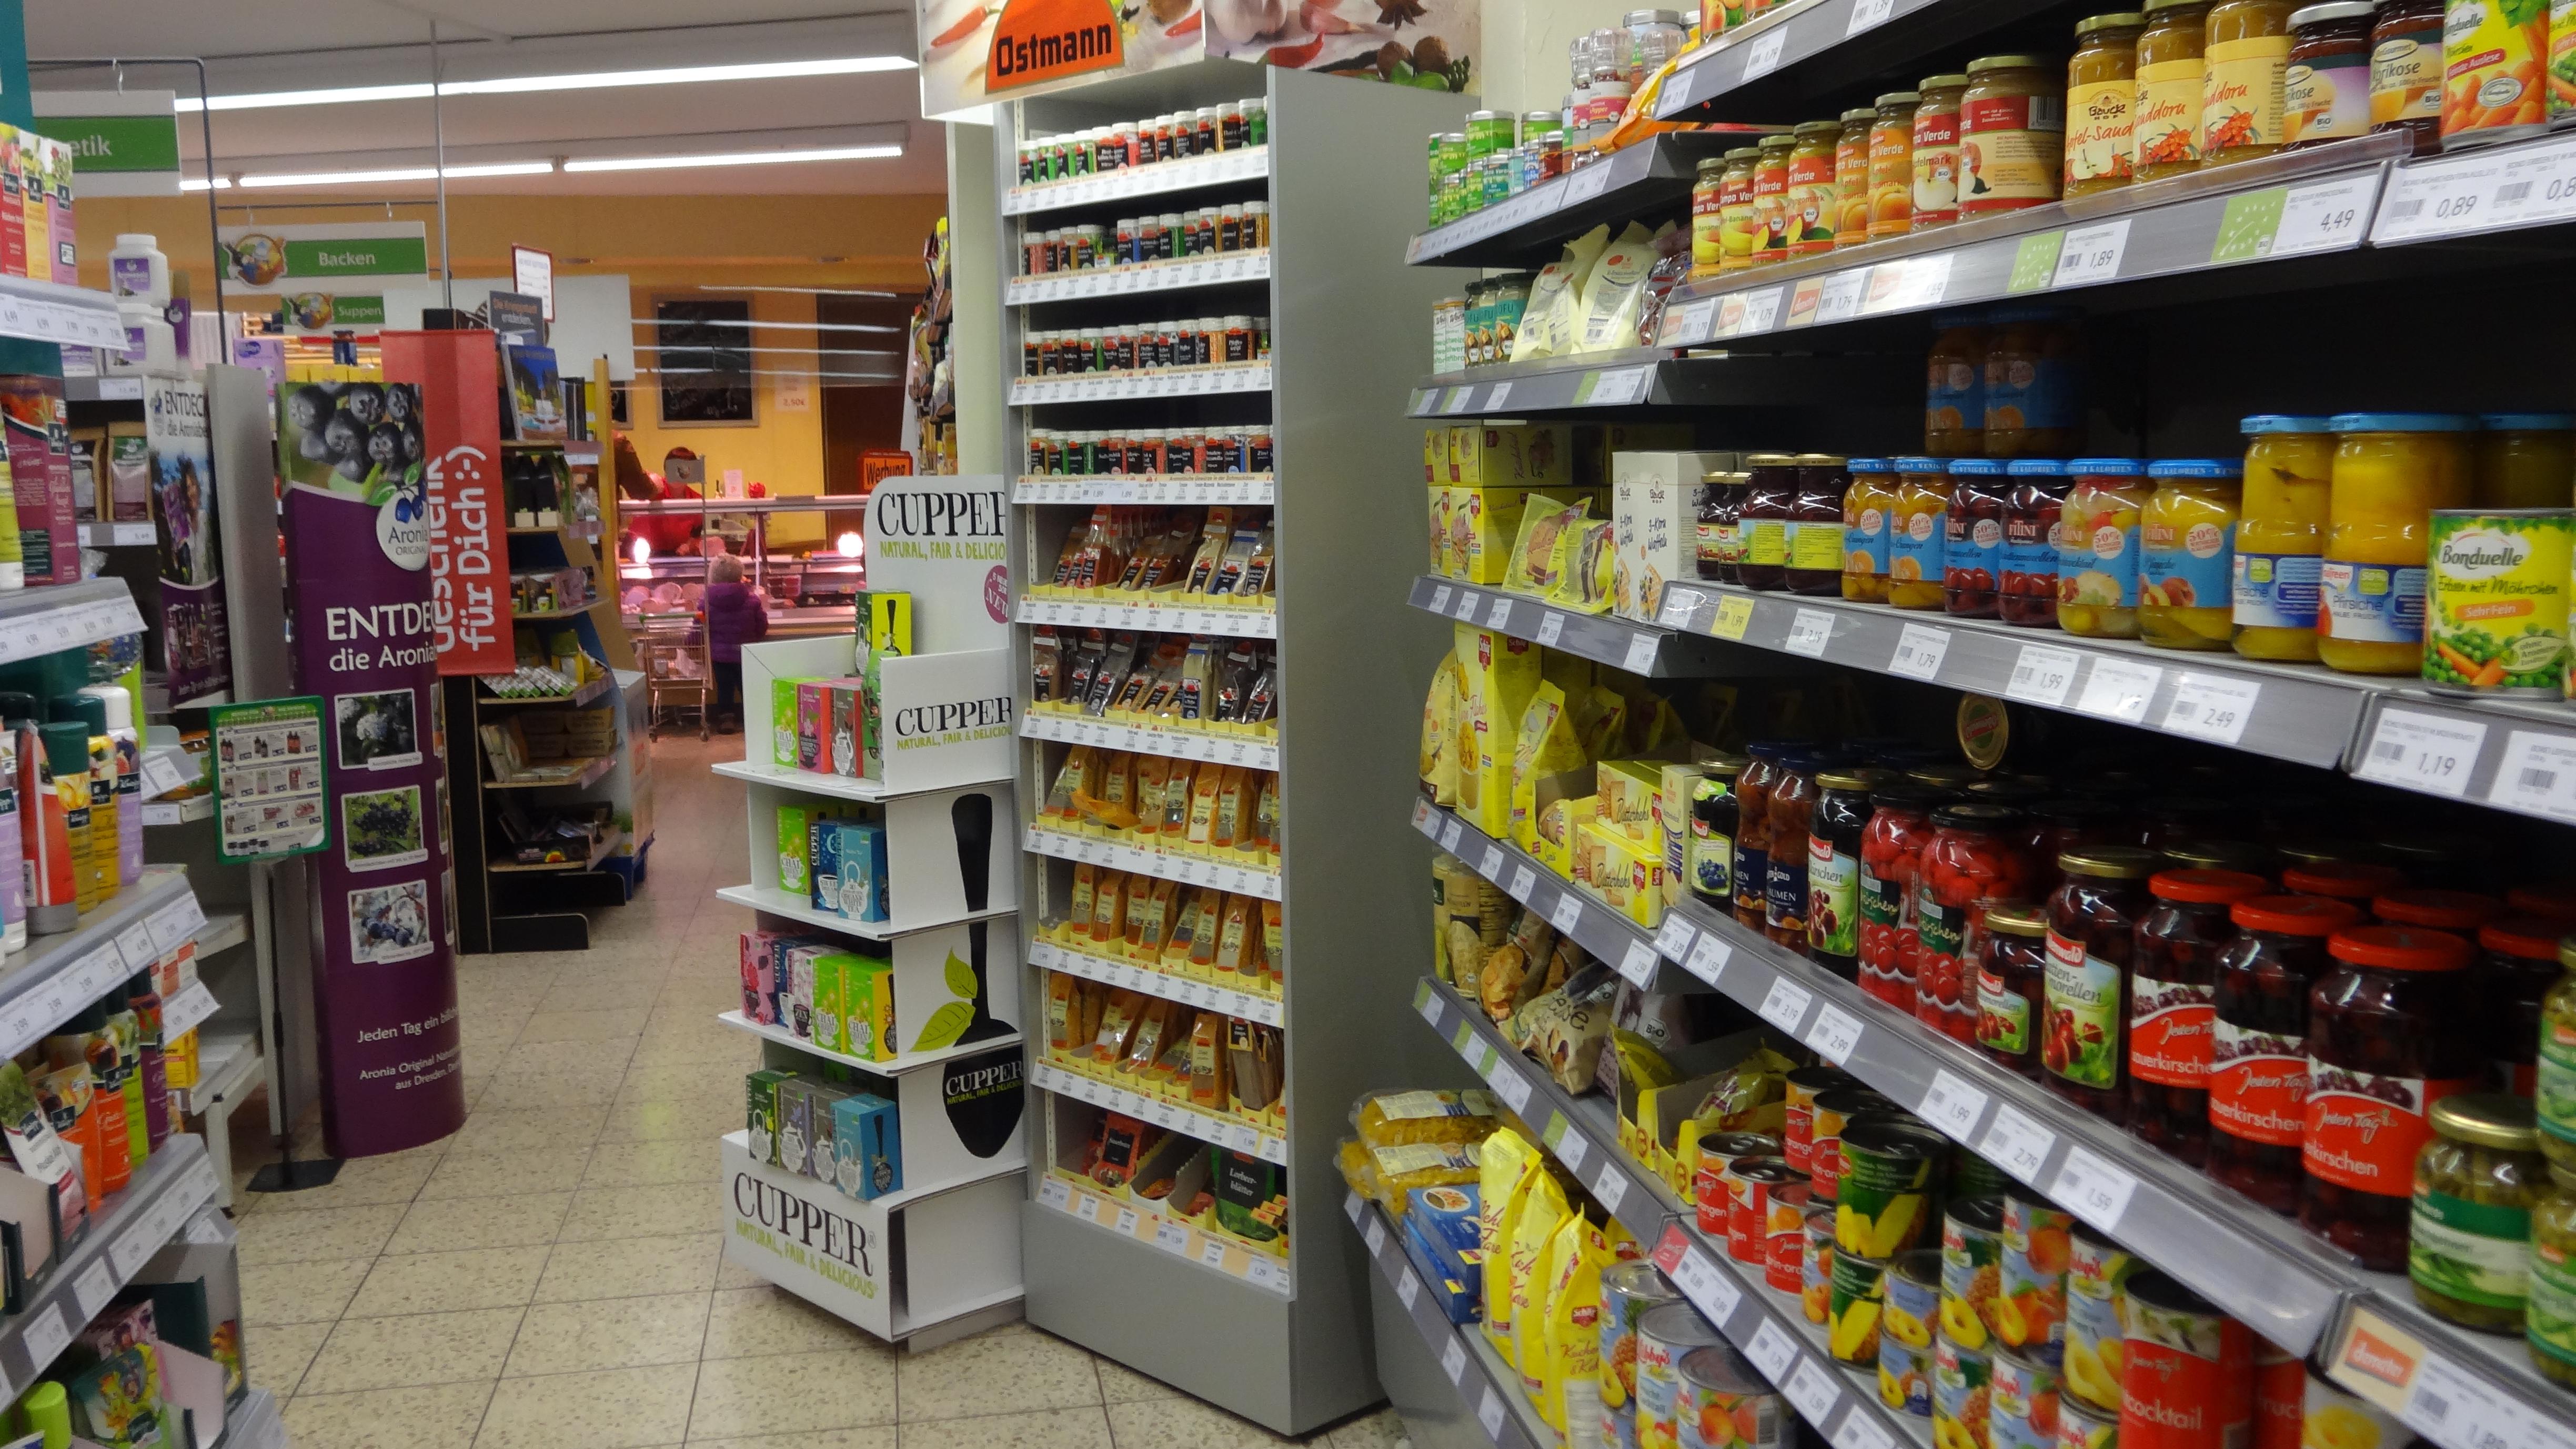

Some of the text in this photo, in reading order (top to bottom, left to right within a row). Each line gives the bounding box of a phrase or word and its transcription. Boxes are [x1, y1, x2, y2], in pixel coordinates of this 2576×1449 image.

[996, 24, 1111, 76] Ostmann
[1924, 130, 1951, 143] Verde
[1878, 144, 1904, 156] Verde
[1760, 182, 1782, 192] Verde
[1794, 172, 1815, 182] Verde
[2435, 195, 2478, 219] 0,89
[2320, 209, 2355, 232] 4,49
[318, 250, 376, 267] Backen
[2089, 249, 2115, 269] 1,89
[338, 305, 382, 318] Suppen
[1836, 294, 1853, 310] 1,79
[388, 525, 429, 545] Aronia
[451, 487, 491, 575] Dich
[880, 540, 928, 562] NATURAL,
[930, 541, 952, 560] FAIR
[955, 541, 963, 559] &
[2442, 545, 2523, 570] Bonduelle
[459, 582, 496, 651] für
[1806, 629, 1822, 643] 2,19
[329, 648, 370, 672] die
[1917, 651, 1936, 668] 1,79
[2040, 671, 2064, 690] 1,99
[895, 697, 1012, 737] CUPPER
[2203, 707, 2236, 728] 2,49
[896, 735, 941, 751] NATURAL,
[942, 732, 963, 746] FAIR
[2418, 752, 2456, 776] 1,19
[810, 824, 820, 867] CUPPER
[357, 1017, 439, 1043] Jeden Tag ein
[1829, 1035, 1849, 1053] 2,99
[359, 1068, 396, 1080] Aronia
[398, 1055, 435, 1073] Original
[945, 1060, 1023, 1096] CUPPER
[395, 1080, 412, 1091] aus
[1949, 1102, 1970, 1121] 1,99
[2014, 1148, 2038, 1171] 2,79
[1230, 1180, 1254, 1197] blätter
[2087, 1188, 2112, 1211] 1,59
[734, 1171, 873, 1276] CUPPER
[736, 1217, 782, 1259] NATURAL,
[784, 1240, 807, 1265] FAIR
[819, 1259, 876, 1300] DELICIOUS
